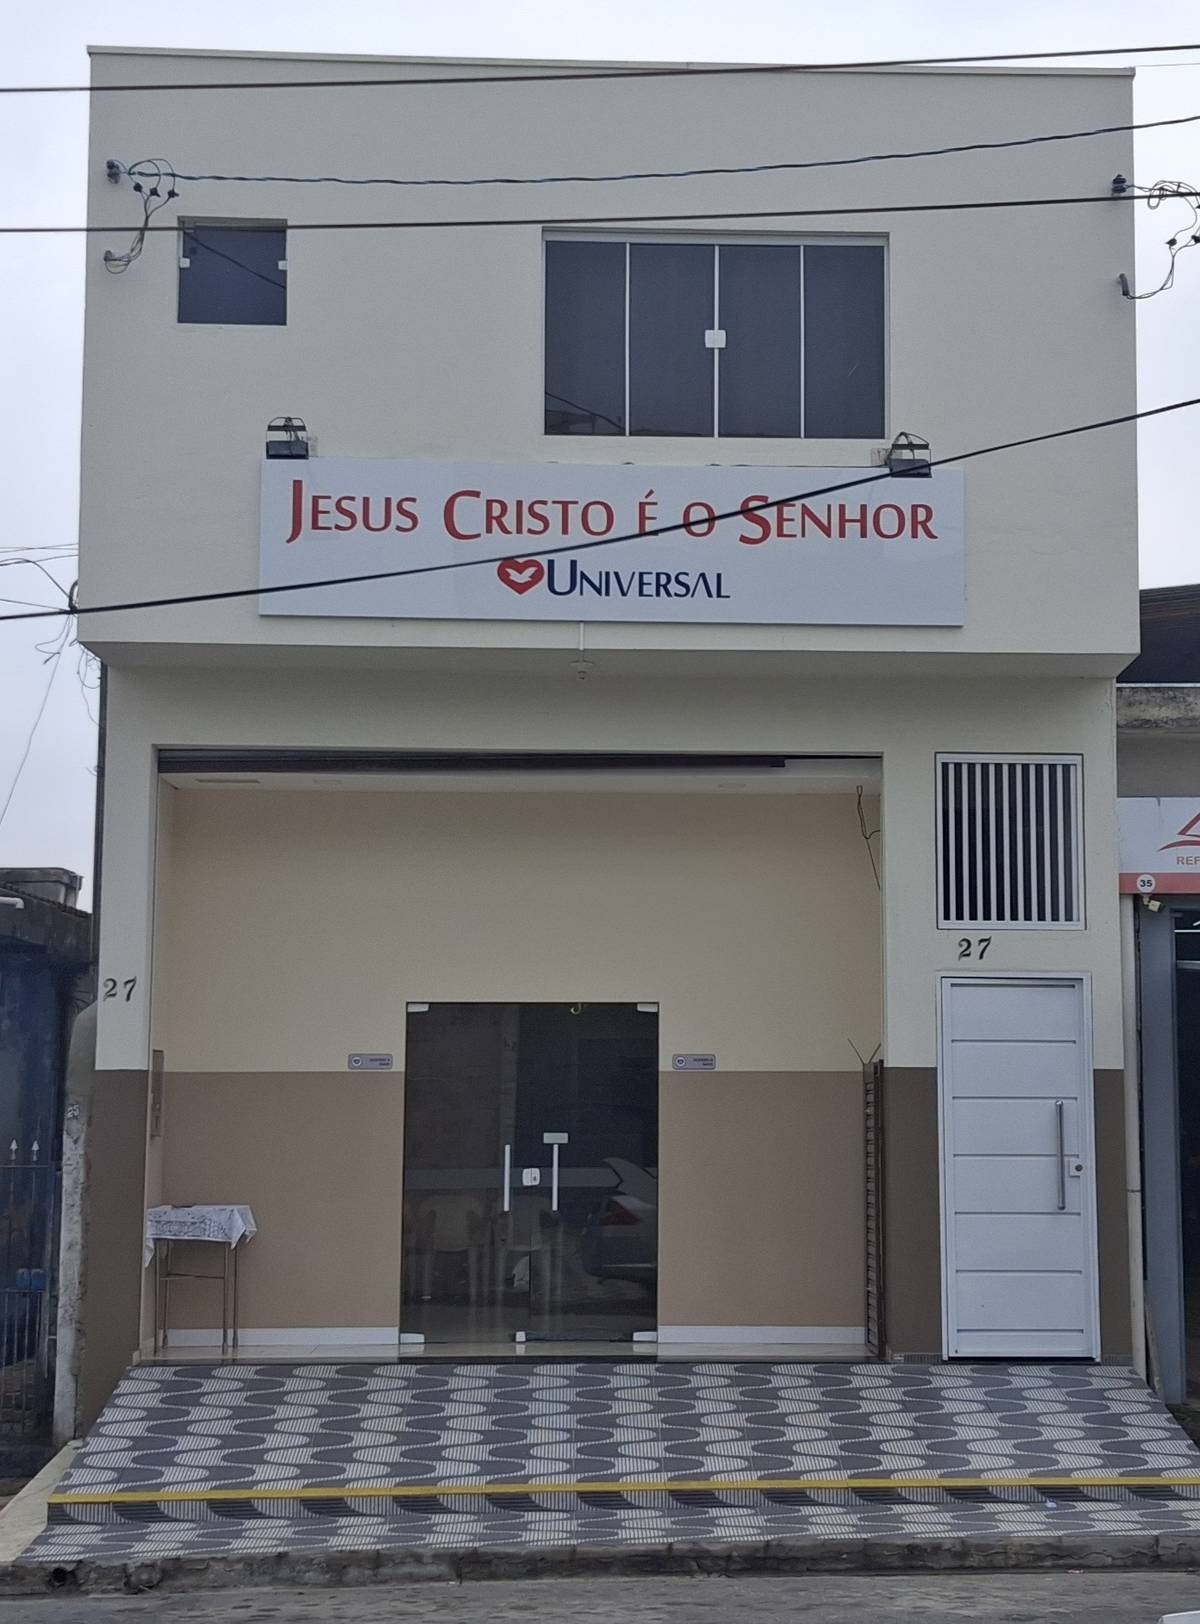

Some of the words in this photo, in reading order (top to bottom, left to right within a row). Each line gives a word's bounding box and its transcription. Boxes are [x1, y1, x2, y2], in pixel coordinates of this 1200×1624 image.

[286, 479, 419, 543] JESUS
[443, 489, 615, 541] CRISTO
[638, 489, 659, 537] É
[682, 502, 716, 537] O
[738, 494, 939, 546] SENHOR
[547, 559, 730, 599] UNIVERSAL
[1139, 879, 1153, 888] 35
[958, 936, 992, 960] 27
[103, 976, 137, 1002] 27
